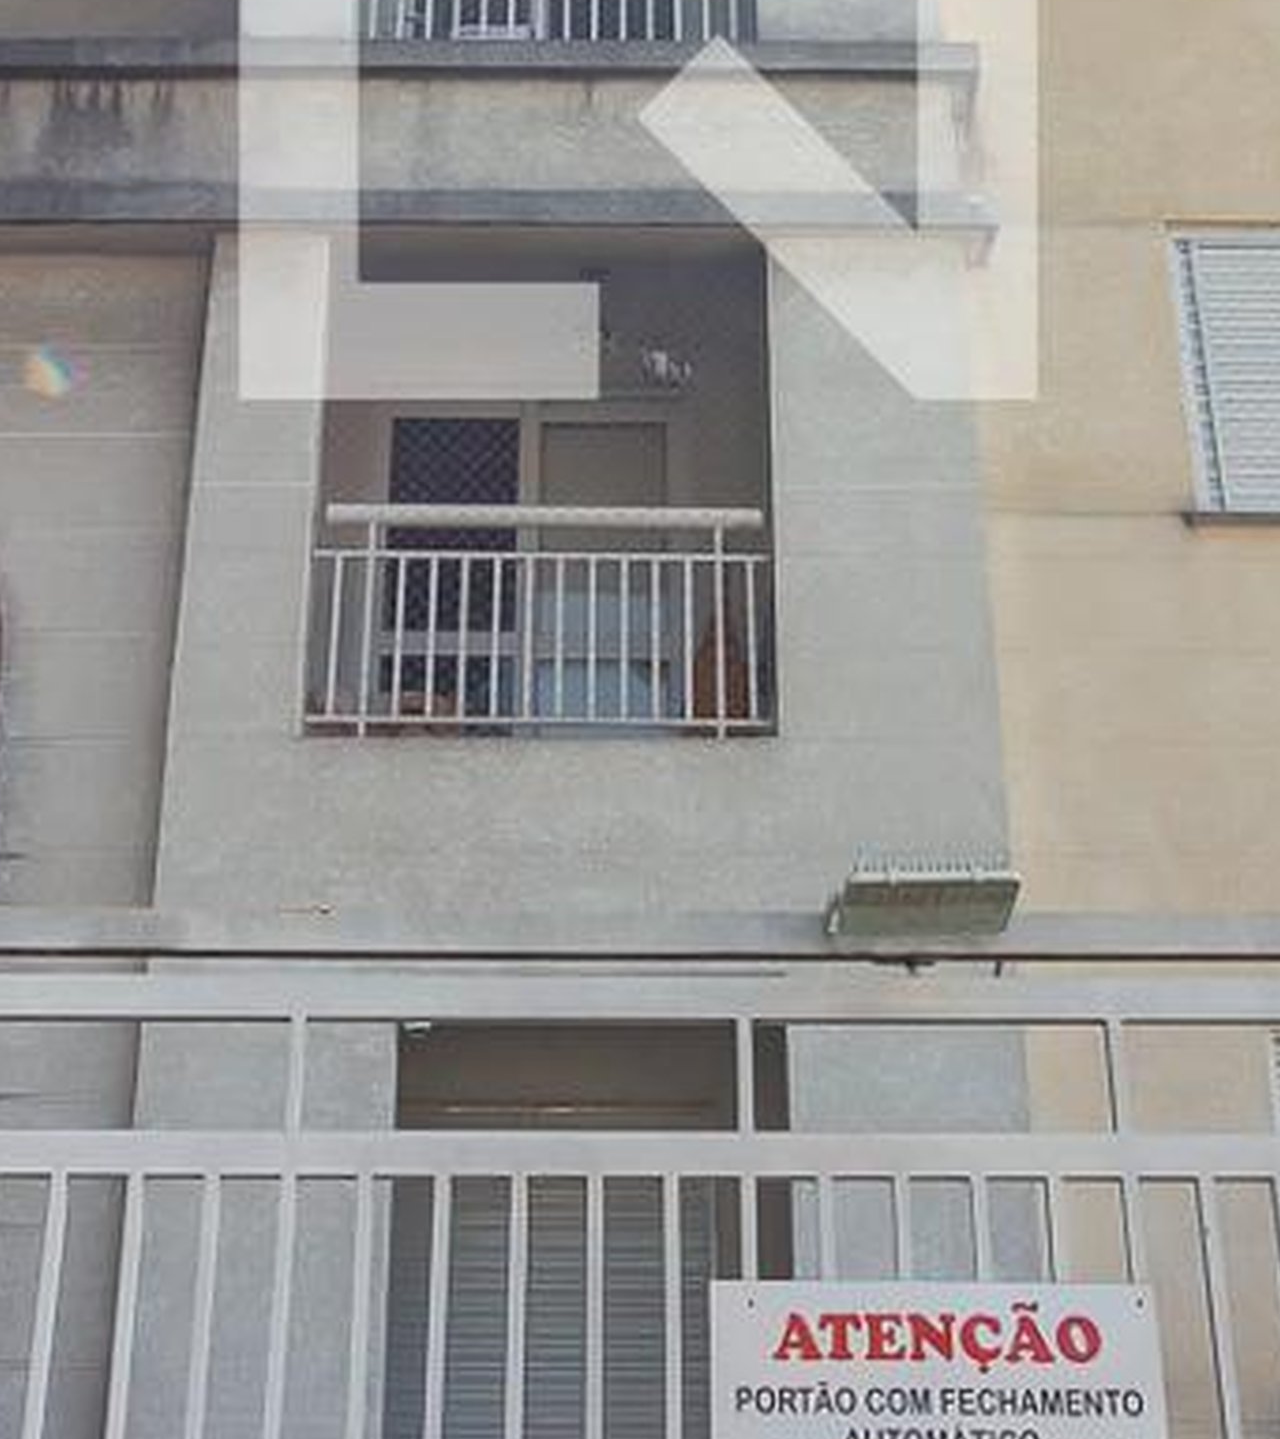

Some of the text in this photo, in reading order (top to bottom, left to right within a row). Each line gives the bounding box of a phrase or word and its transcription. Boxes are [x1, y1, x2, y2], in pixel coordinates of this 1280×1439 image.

[772, 1302, 1102, 1373] ATENÇÃO
[735, 1381, 1145, 1418] PORTÃO COM FECHAMENTO
